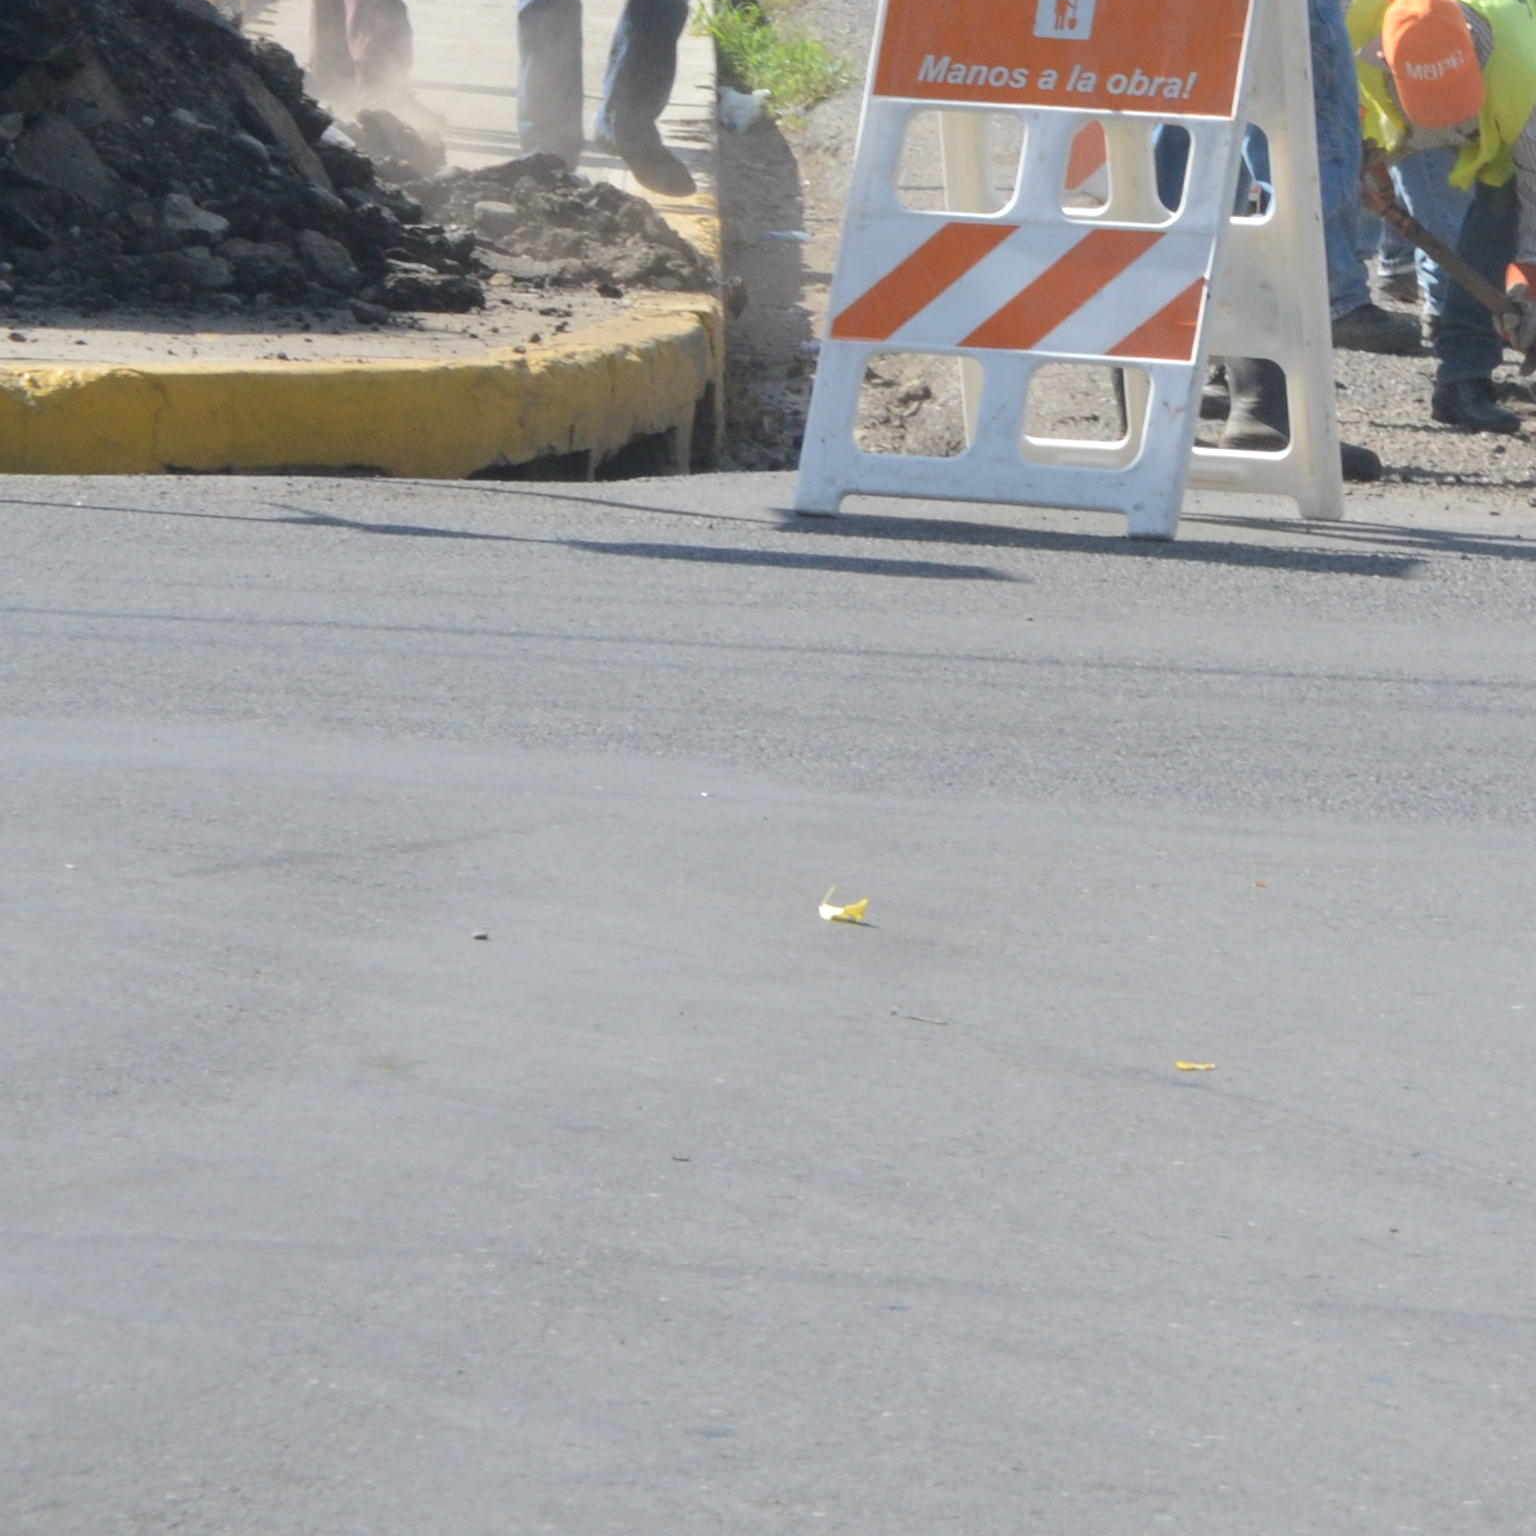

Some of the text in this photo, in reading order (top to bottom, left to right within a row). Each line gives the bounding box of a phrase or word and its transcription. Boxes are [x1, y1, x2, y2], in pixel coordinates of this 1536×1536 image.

[917, 55, 1199, 99] Manos a la obra!
